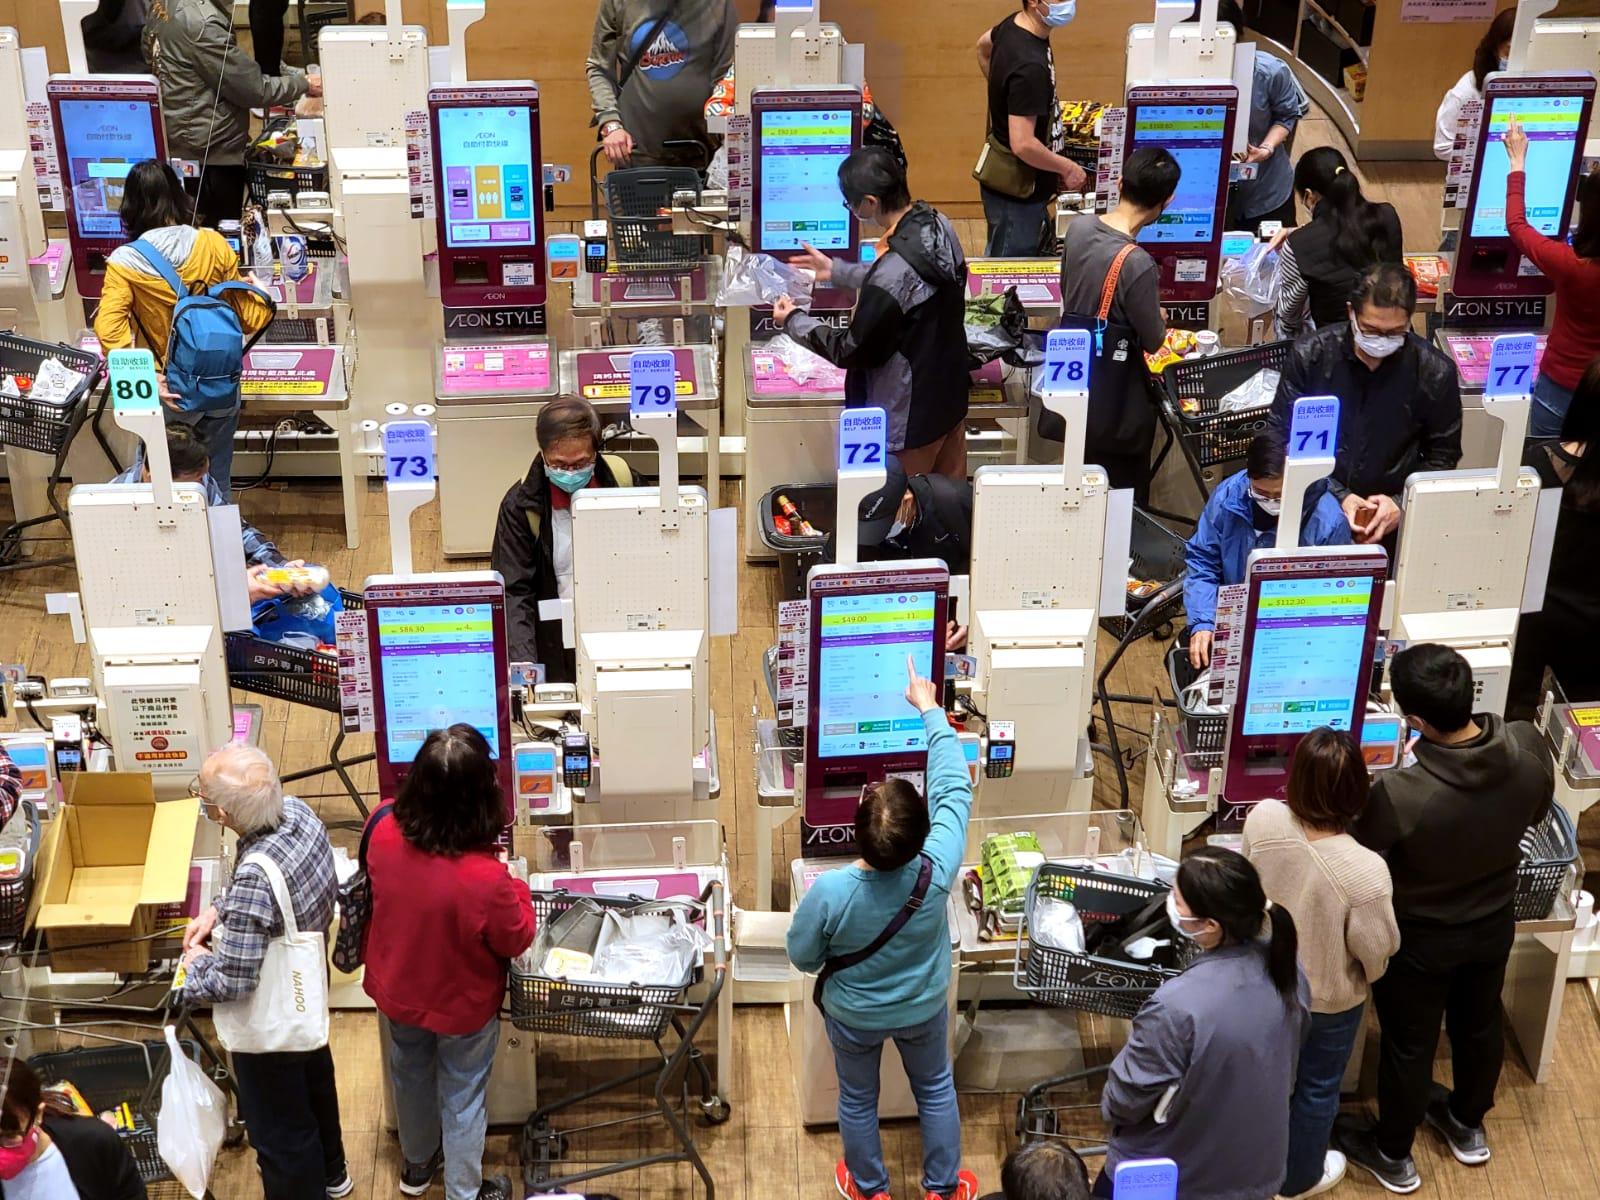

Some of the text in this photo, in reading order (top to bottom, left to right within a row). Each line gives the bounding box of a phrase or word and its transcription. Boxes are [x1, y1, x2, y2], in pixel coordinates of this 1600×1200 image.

[495, 310, 544, 326] STYLE
[1167, 307, 1206, 321] TYLE
[1495, 301, 1542, 315] STYLE
[1049, 361, 1084, 381] 78
[1495, 365, 1530, 386] 77
[116, 379, 153, 400] 80
[635, 385, 672, 405] 79
[1296, 430, 1329, 451] 71
[844, 442, 881, 464] 72
[390, 455, 429, 478] 73
